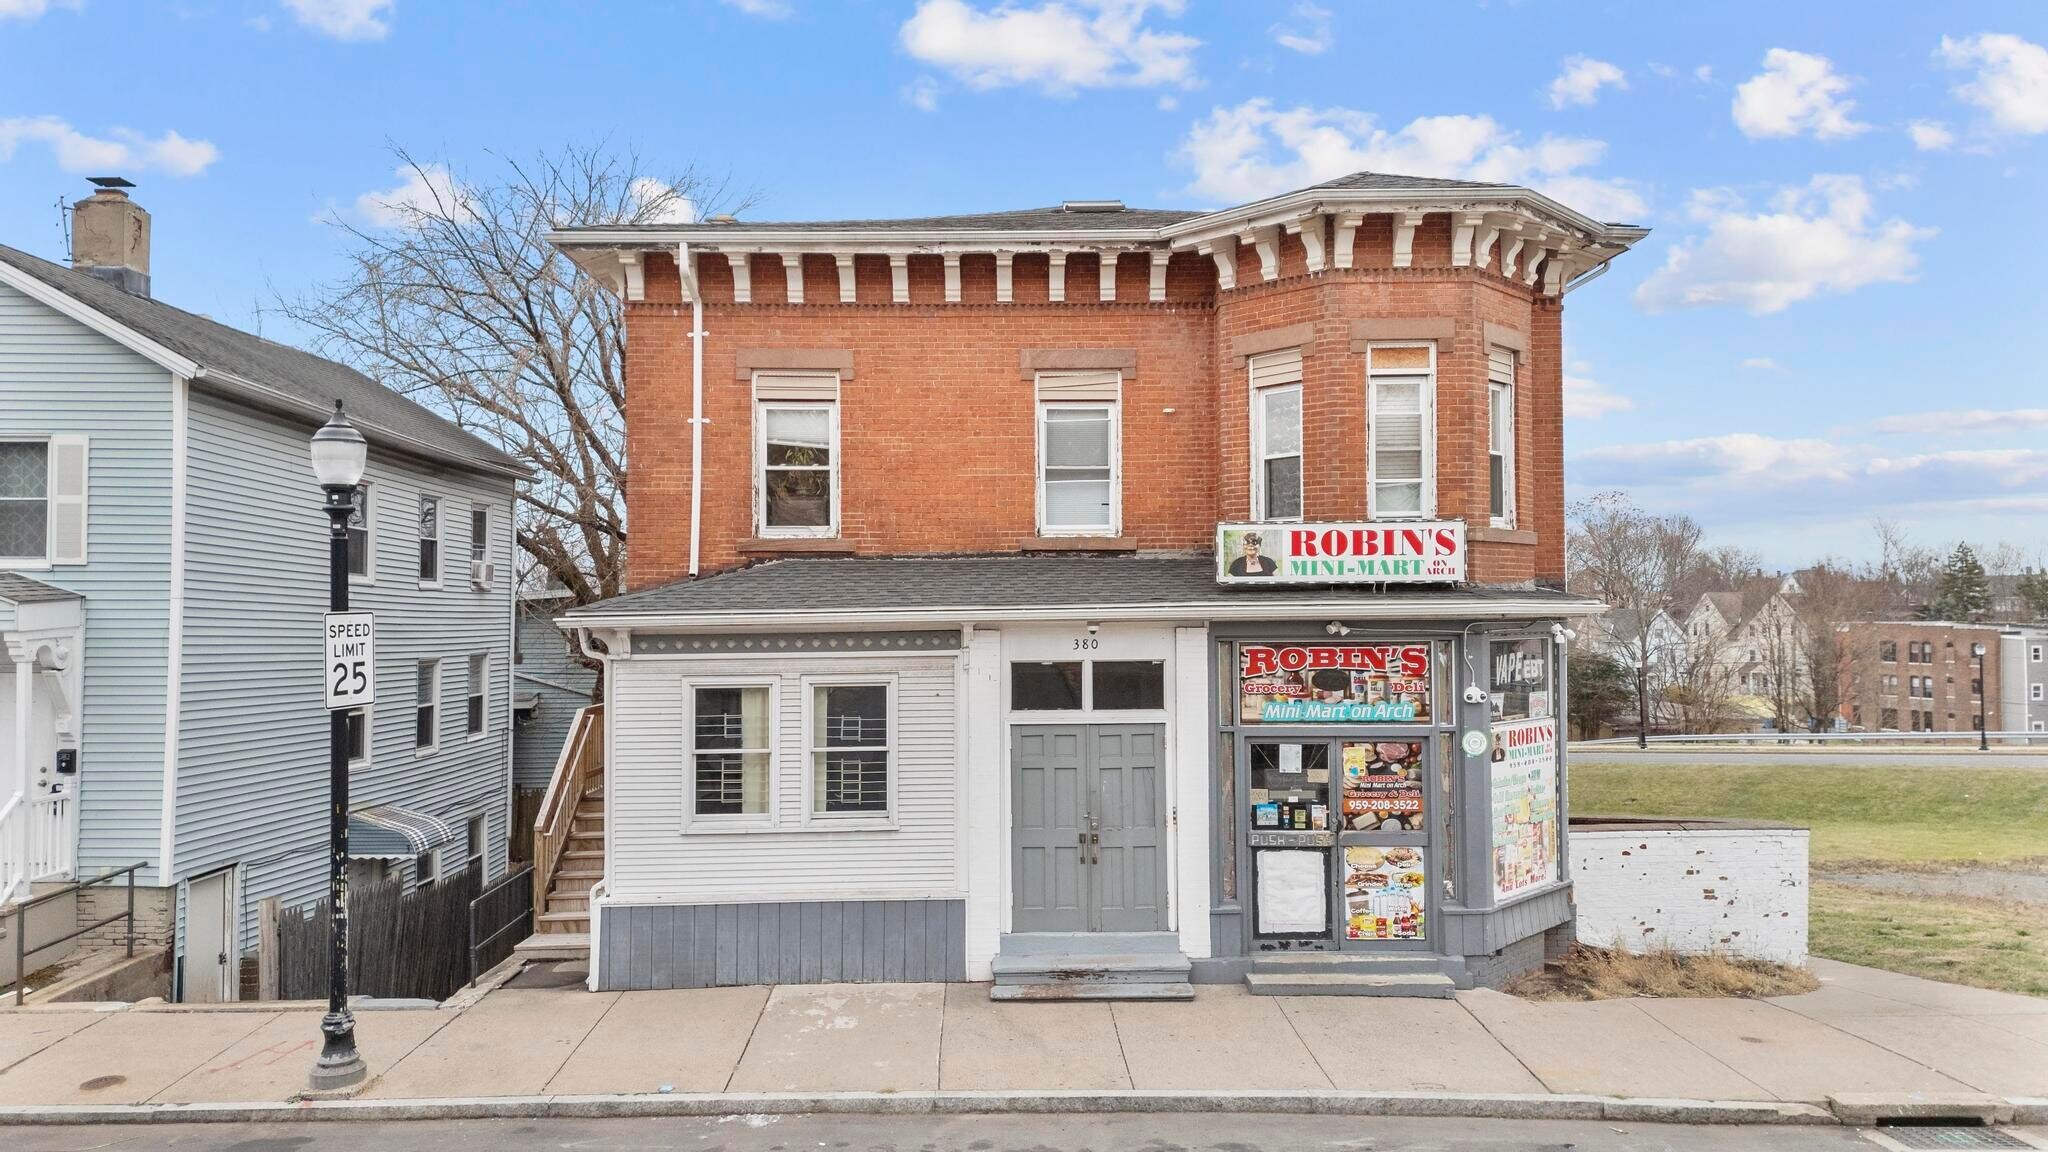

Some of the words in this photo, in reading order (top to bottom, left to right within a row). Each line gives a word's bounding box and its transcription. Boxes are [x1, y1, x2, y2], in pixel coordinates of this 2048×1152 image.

[1289, 529, 1457, 557] ROBIN'S
[1290, 560, 1424, 576] MINI-MART
[1425, 567, 1456, 575] ARCH
[329, 624, 370, 638] SPEED
[334, 643, 366, 657] LIMIT
[1073, 638, 1098, 650] 380
[1244, 647, 1428, 677] ROBIN'S
[1496, 651, 1523, 686] VAPE
[1524, 659, 1545, 680] EBT
[333, 661, 367, 696] 25
[1244, 682, 1302, 695] Grocery
[1393, 681, 1426, 693] Deli
[1265, 704, 1300, 718] Mini
[1305, 704, 1346, 718] Mart
[1351, 707, 1371, 718] on
[1375, 704, 1414, 718] Arch
[1348, 790, 1388, 798] Grocery
[1399, 790, 1421, 798] Deli
[1349, 800, 1419, 810] 959-208-3522
[1251, 834, 1285, 846] PUSH
